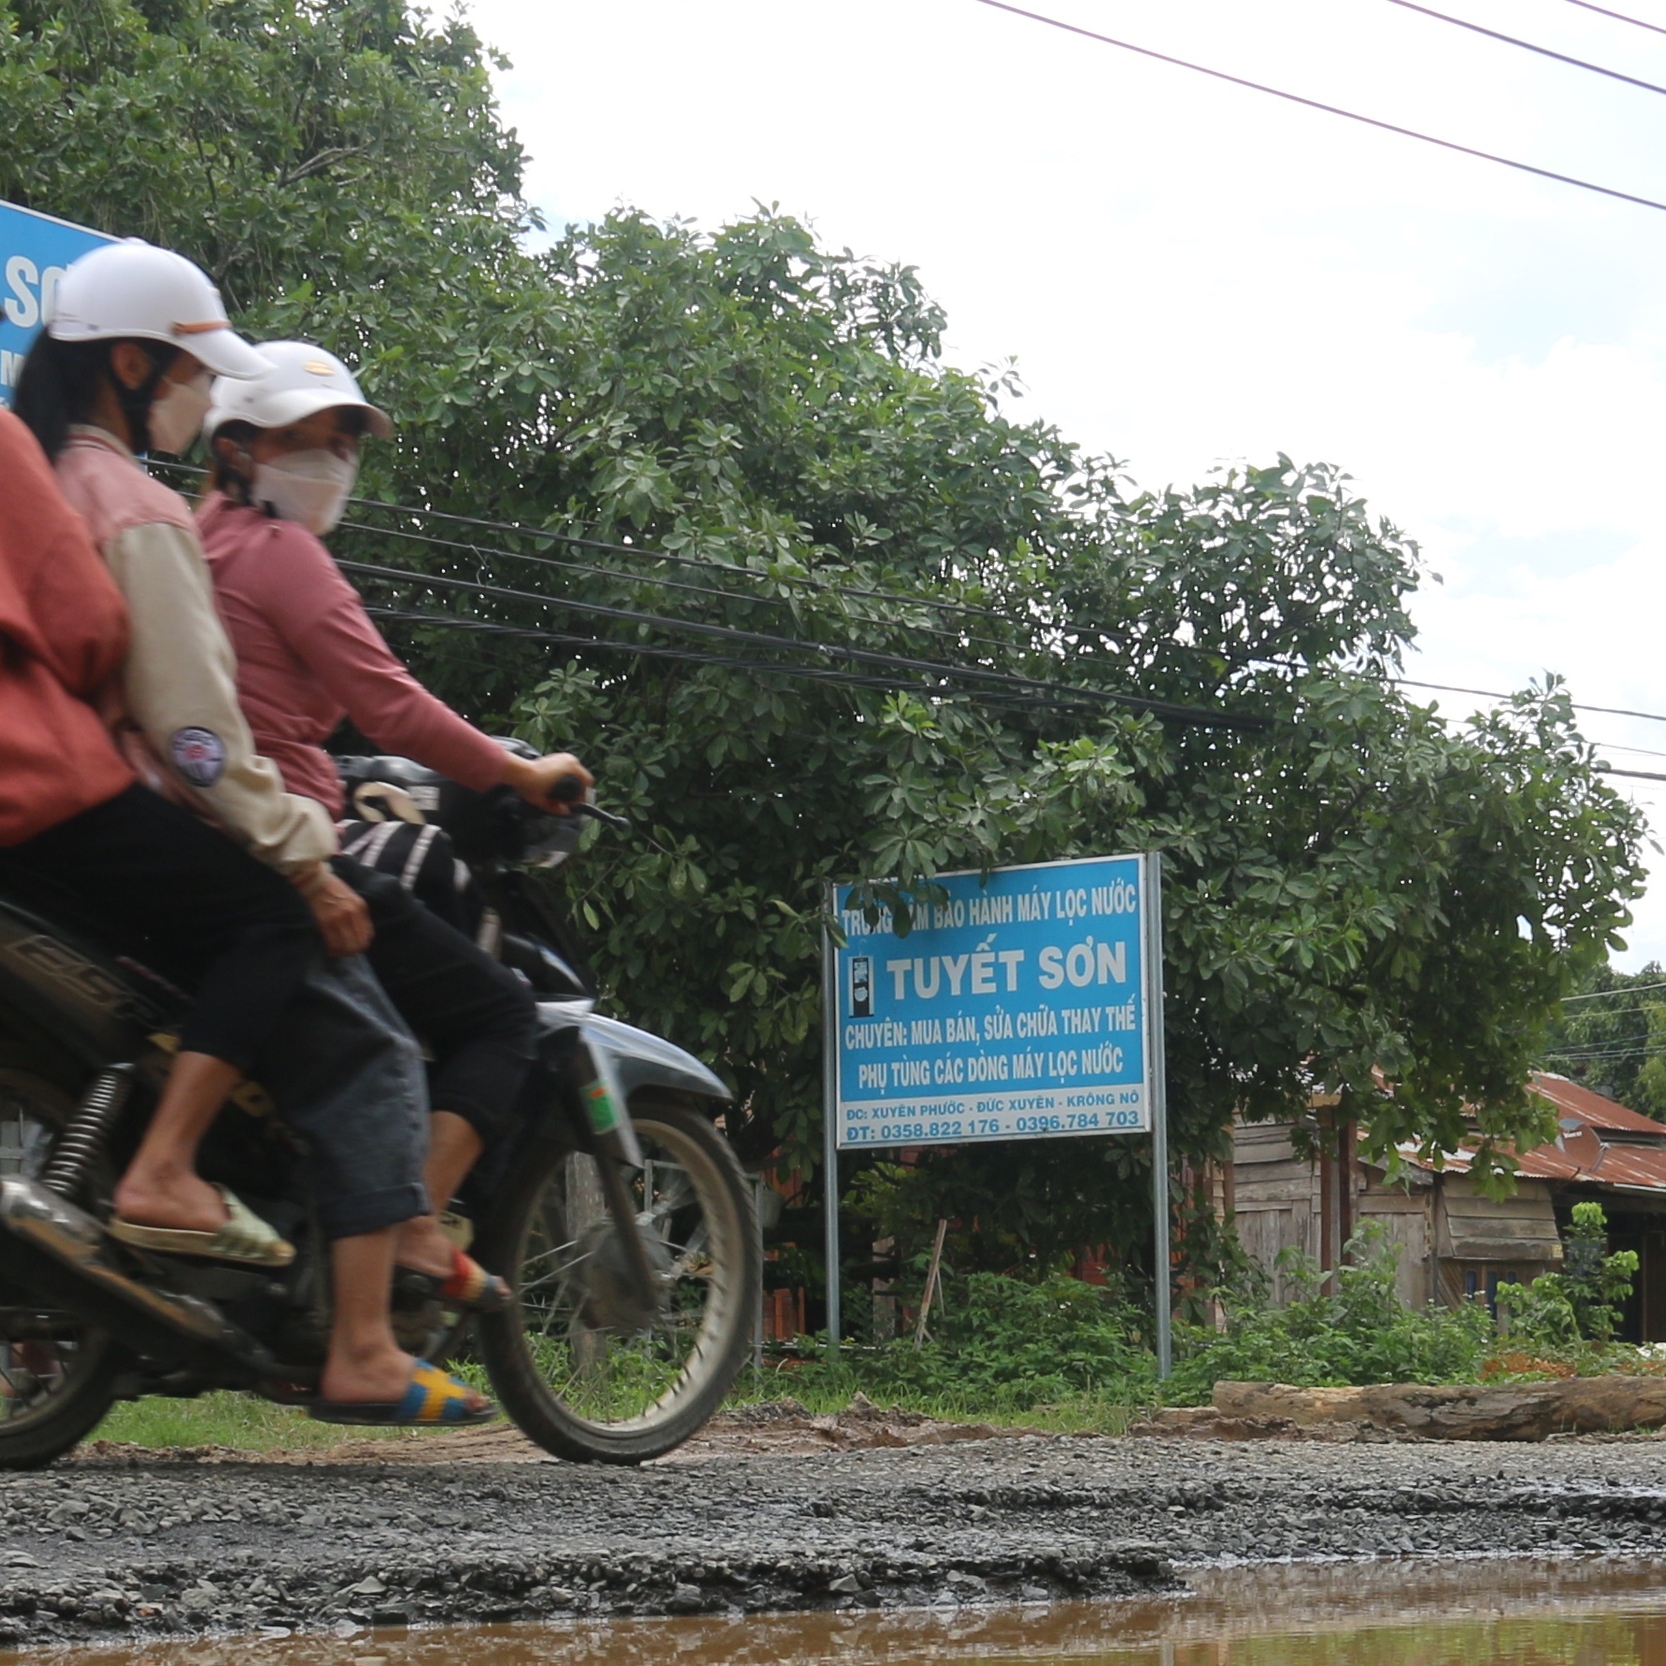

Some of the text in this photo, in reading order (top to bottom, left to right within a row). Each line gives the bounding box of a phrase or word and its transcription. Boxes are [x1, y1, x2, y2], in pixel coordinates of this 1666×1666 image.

[969, 889, 1013, 926] HÀNH
[1018, 884, 1052, 922] MÁY
[1056, 888, 1087, 926] LỌC
[1092, 877, 1136, 916] NƯỚC
[886, 932, 1127, 1000] TUYẾT SƠN
[845, 993, 1136, 1049] CHUYÊN: MUA BÁN, SỬA CHỮA THAY THẾ
[858, 1040, 1123, 1095] PHỤ TÙNG CÁC DÒNG MÁY LỌC NƯỚC
[846, 1088, 1140, 1121] ĐC: XUYÊN PHƯỚC ĐỨC XUYÊN KRÔNG NÔ
[846, 1126, 876, 1141] ĐT:
[880, 1121, 963, 1140] 0358.822
[967, 1119, 1000, 1135] 176
[1105, 1110, 1139, 1126] 703
